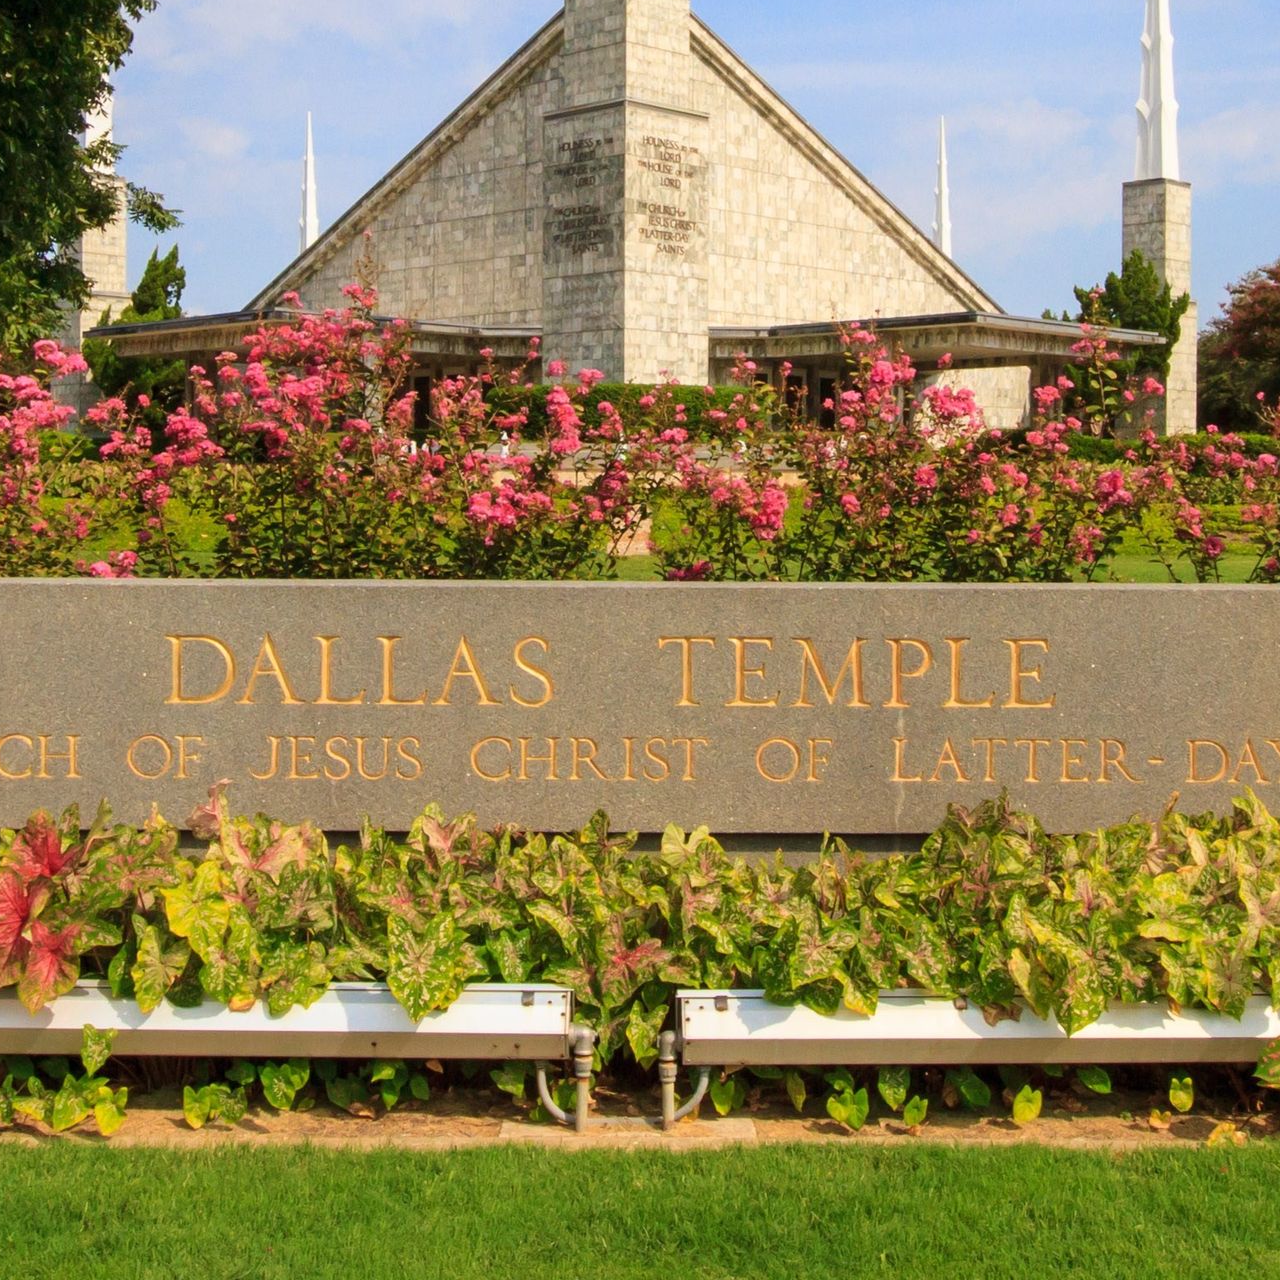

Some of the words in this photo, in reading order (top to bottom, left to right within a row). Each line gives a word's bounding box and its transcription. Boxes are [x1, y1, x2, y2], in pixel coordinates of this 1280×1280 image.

[642, 135, 679, 150] HOLINESS
[660, 151, 681, 163] LORD
[647, 161, 673, 175] HOUSE
[660, 176, 681, 189] LORD
[656, 242, 685, 256] SAINTS
[165, 632, 556, 708] DALLAS
[657, 635, 1057, 710] TEMPLE
[127, 733, 204, 780] OF
[251, 734, 424, 782] JESUS
[469, 736, 710, 783] CHRIST
[755, 736, 834, 784] OF
